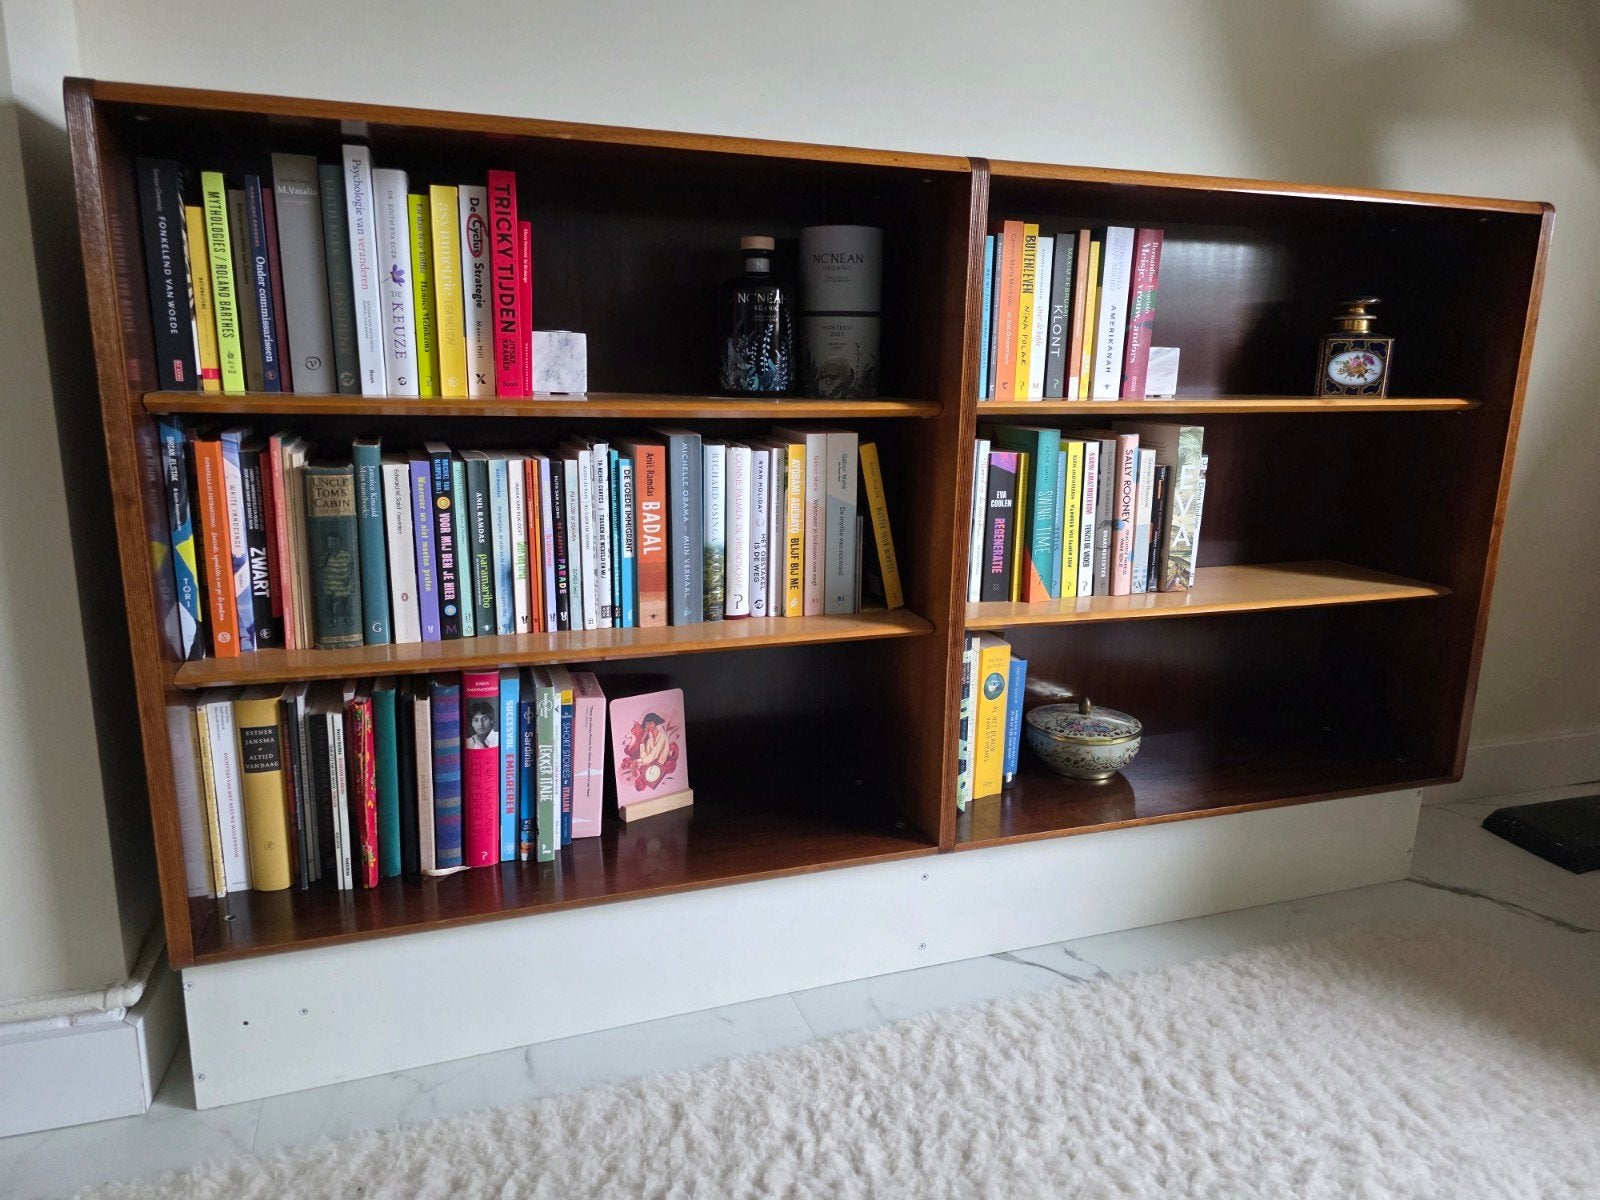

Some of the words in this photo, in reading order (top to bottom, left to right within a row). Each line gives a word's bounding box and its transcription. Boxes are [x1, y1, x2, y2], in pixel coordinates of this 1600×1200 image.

[351, 159, 365, 216] Psychologie
[470, 198, 480, 212] De
[208, 191, 226, 252] MYTHOLOGIES
[355, 218, 366, 235] van
[494, 184, 514, 258] TRICKY
[158, 216, 172, 275] FONKELEND
[438, 203, 454, 296] asymmetrie
[470, 220, 482, 255] Cyclus
[256, 256, 268, 286] Onder
[356, 237, 370, 290] veranderen
[1022, 235, 1036, 294] BUITENLEVEN
[1136, 242, 1150, 281] Meisje,
[1148, 242, 1159, 282] Bernardine
[164, 278, 175, 299] VAN
[215, 264, 230, 298] ROLAND
[420, 282, 428, 307] Hannes
[472, 263, 484, 308] Strategie
[497, 264, 517, 333] TIJDEN
[1063, 278, 1071, 317] FEBRUARI
[1133, 285, 1146, 322] vrouw,
[166, 301, 178, 335] WOEDE
[219, 300, 234, 338] BARTHES
[259, 288, 274, 362] commissarissen
[392, 302, 406, 359] KEUZE
[1022, 306, 1030, 330] NINA
[1051, 305, 1063, 357] KLONT
[1021, 334, 1029, 365] POLAK
[1106, 305, 1116, 373] AMERIKANAH
[502, 339, 510, 371] KRAMER
[167, 436, 176, 456] BRIAN
[646, 453, 654, 468] Anil
[168, 459, 178, 481] ELSTAK
[358, 465, 367, 481] Mijn
[368, 465, 377, 491] Jamaica
[623, 469, 630, 480] DE
[735, 454, 743, 486] CONNIE
[1124, 449, 1133, 476] SALLY
[230, 484, 238, 506] WHITE
[313, 478, 350, 487] UNCLE
[316, 488, 347, 498] TOM'S
[418, 477, 427, 509] Waarover
[646, 470, 655, 496] Ramdas
[996, 490, 1007, 499] EVA
[314, 498, 350, 508] CABIN
[369, 492, 378, 517] Kincaid
[419, 512, 428, 521] we
[735, 489, 743, 520] PALMEN
[991, 499, 1012, 508] COOLEN
[1037, 490, 1053, 520] SWING
[1122, 480, 1132, 523] ROONEY
[231, 510, 240, 548] INNOCENCE
[420, 525, 429, 538] niet
[439, 513, 451, 533] VOOR
[476, 512, 484, 543] RAMDAS
[624, 510, 632, 553] IMMIGRANT
[642, 502, 661, 555] BADAL
[421, 542, 430, 566] moeten
[440, 536, 452, 551] MIJ
[790, 538, 799, 560] BLIJF
[992, 518, 1005, 574] REGENERATIE
[1035, 527, 1051, 555] TIME
[250, 547, 269, 597] ZWART
[441, 554, 453, 568] BEN
[735, 536, 743, 588] VRIENDSCHAP
[754, 552, 759, 562] DE
[790, 563, 799, 576] BIJ
[422, 570, 431, 592] praten
[442, 572, 454, 580] JE
[443, 583, 455, 600] HIER
[478, 554, 492, 608] paramaribo
[558, 559, 566, 594] PARADE
[790, 578, 799, 589] ME
[182, 578, 191, 607] TORI
[506, 700, 514, 750] SUCCESVOL
[524, 731, 532, 768] Sardinia
[539, 745, 552, 774] LEKKER
[224, 752, 232, 777] DICHTERS
[228, 802, 236, 823] NIEUWE
[506, 754, 514, 814] EMIGREREN
